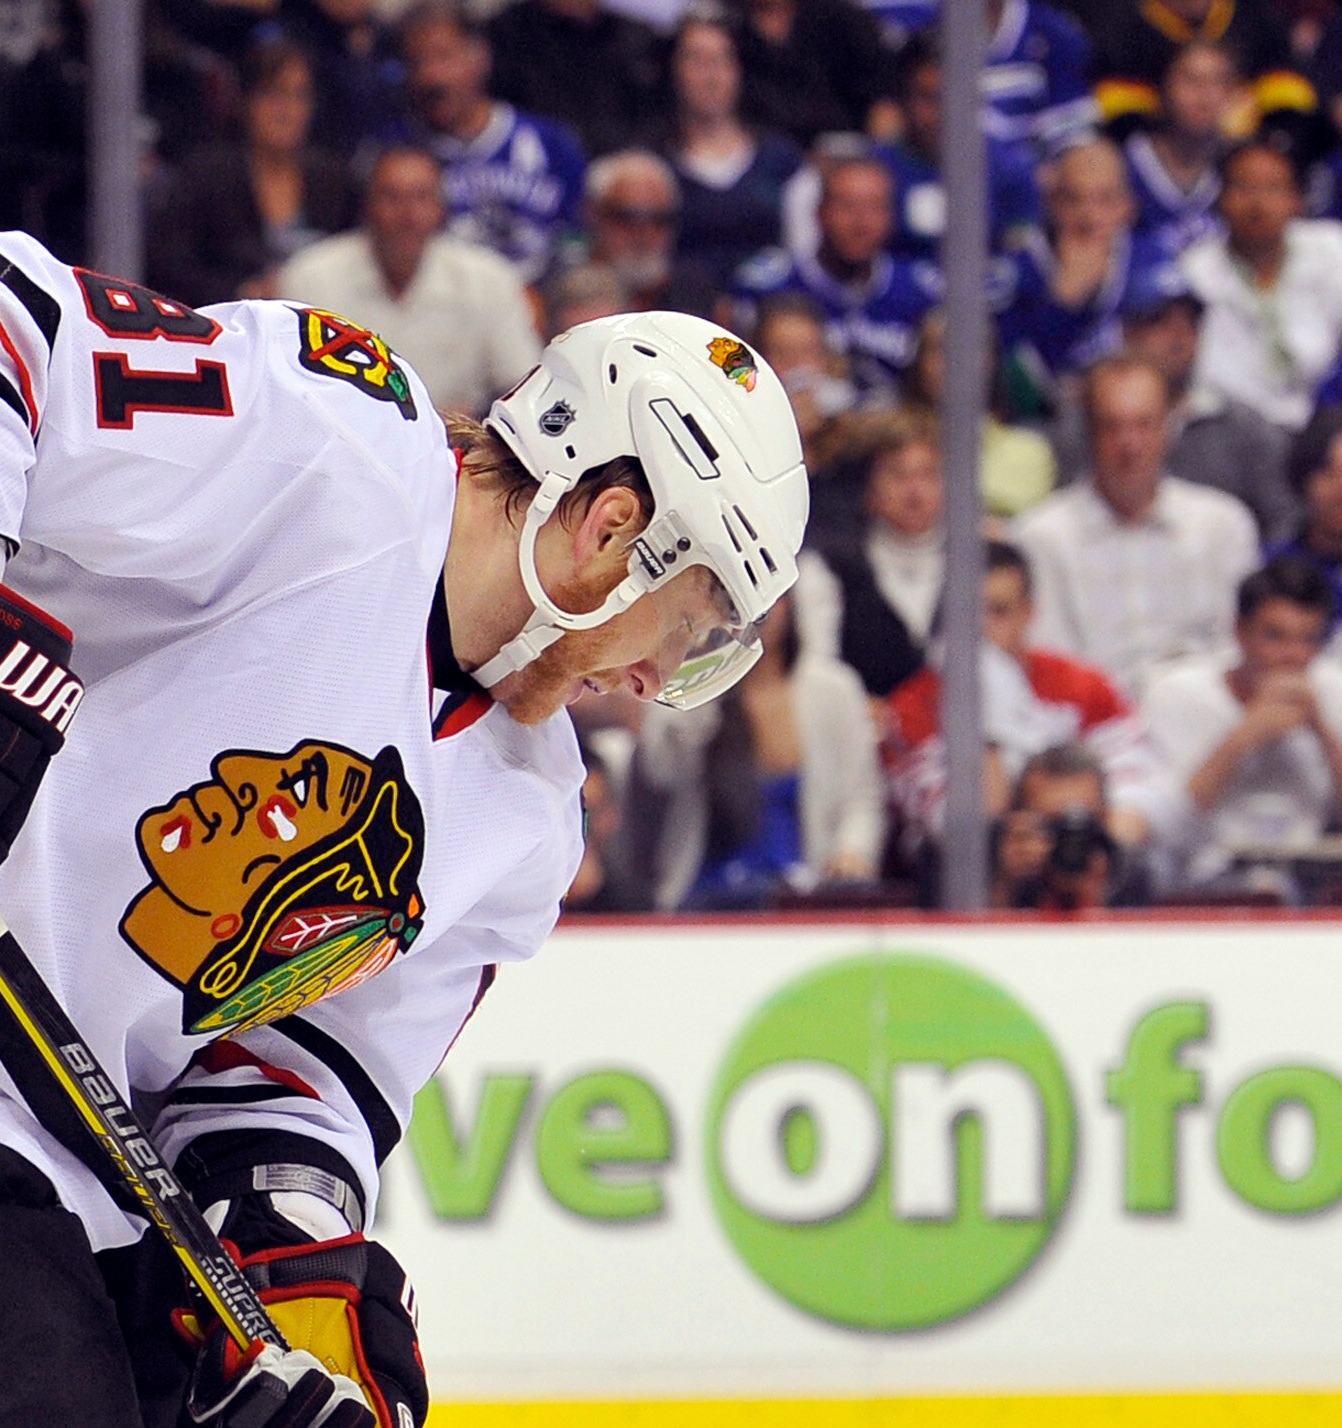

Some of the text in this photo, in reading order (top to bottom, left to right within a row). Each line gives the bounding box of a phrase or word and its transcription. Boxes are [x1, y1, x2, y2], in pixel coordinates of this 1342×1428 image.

[73, 266, 235, 430] 81
[721, 1058, 1048, 1223] on
[1106, 1001, 1342, 1215] fo
